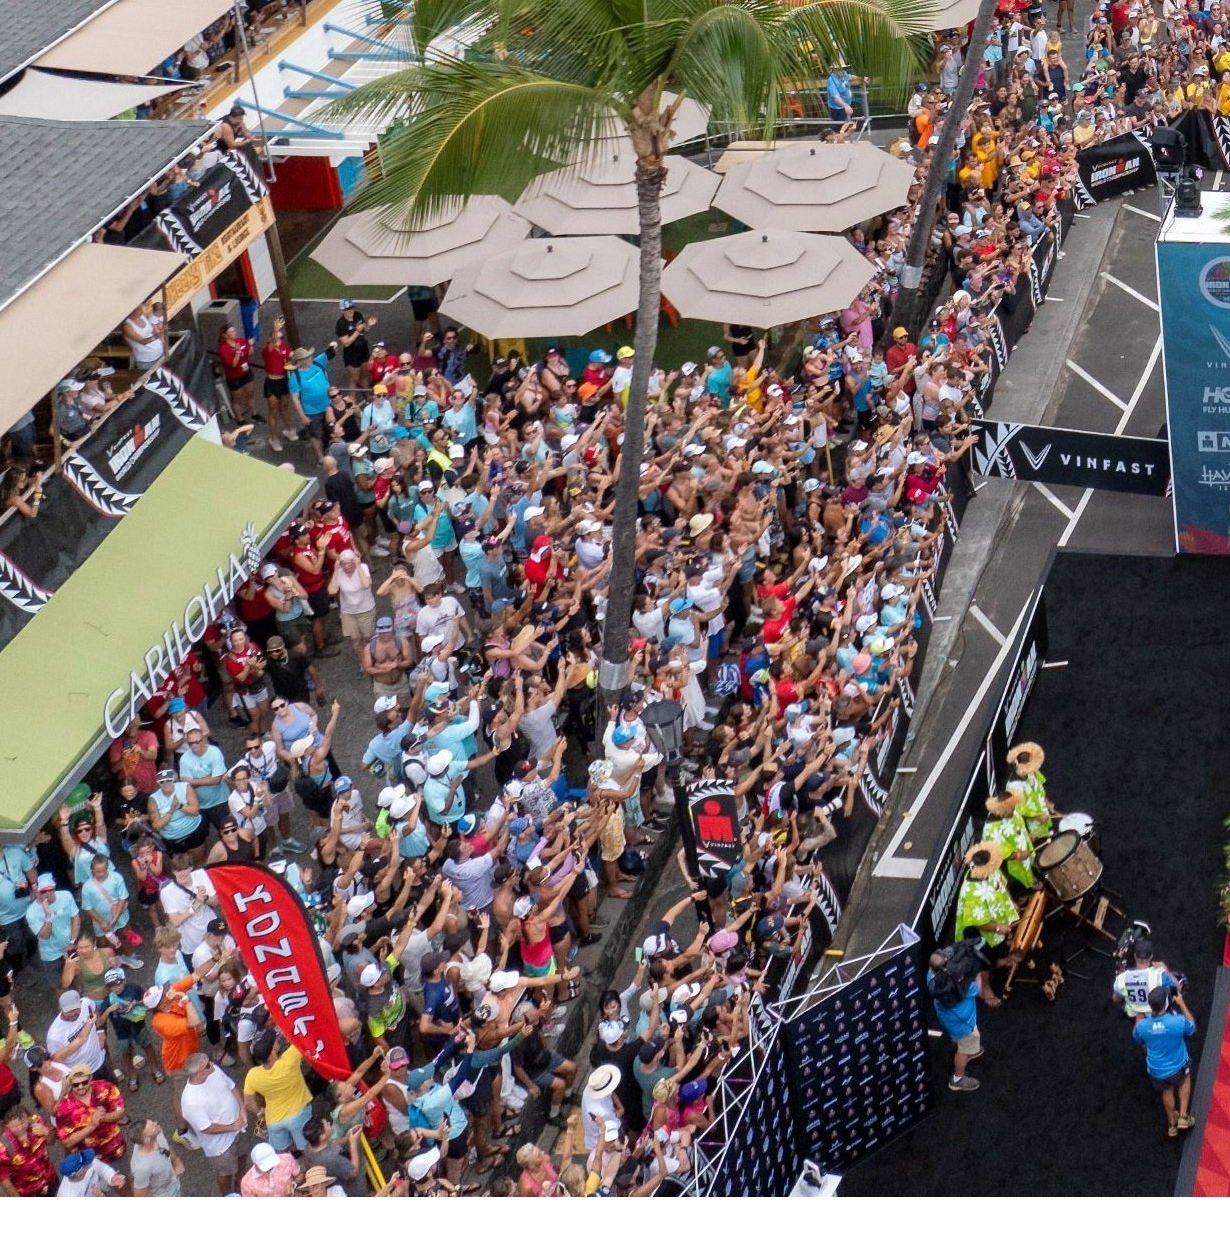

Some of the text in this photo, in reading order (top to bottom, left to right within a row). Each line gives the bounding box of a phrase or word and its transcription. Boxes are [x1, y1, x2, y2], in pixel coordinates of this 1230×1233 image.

[1203, 406, 1217, 414] FLY
[1060, 453, 1155, 477] VINFAST
[103, 552, 249, 740] CARILOHA
[1127, 988, 1147, 1003] 59
